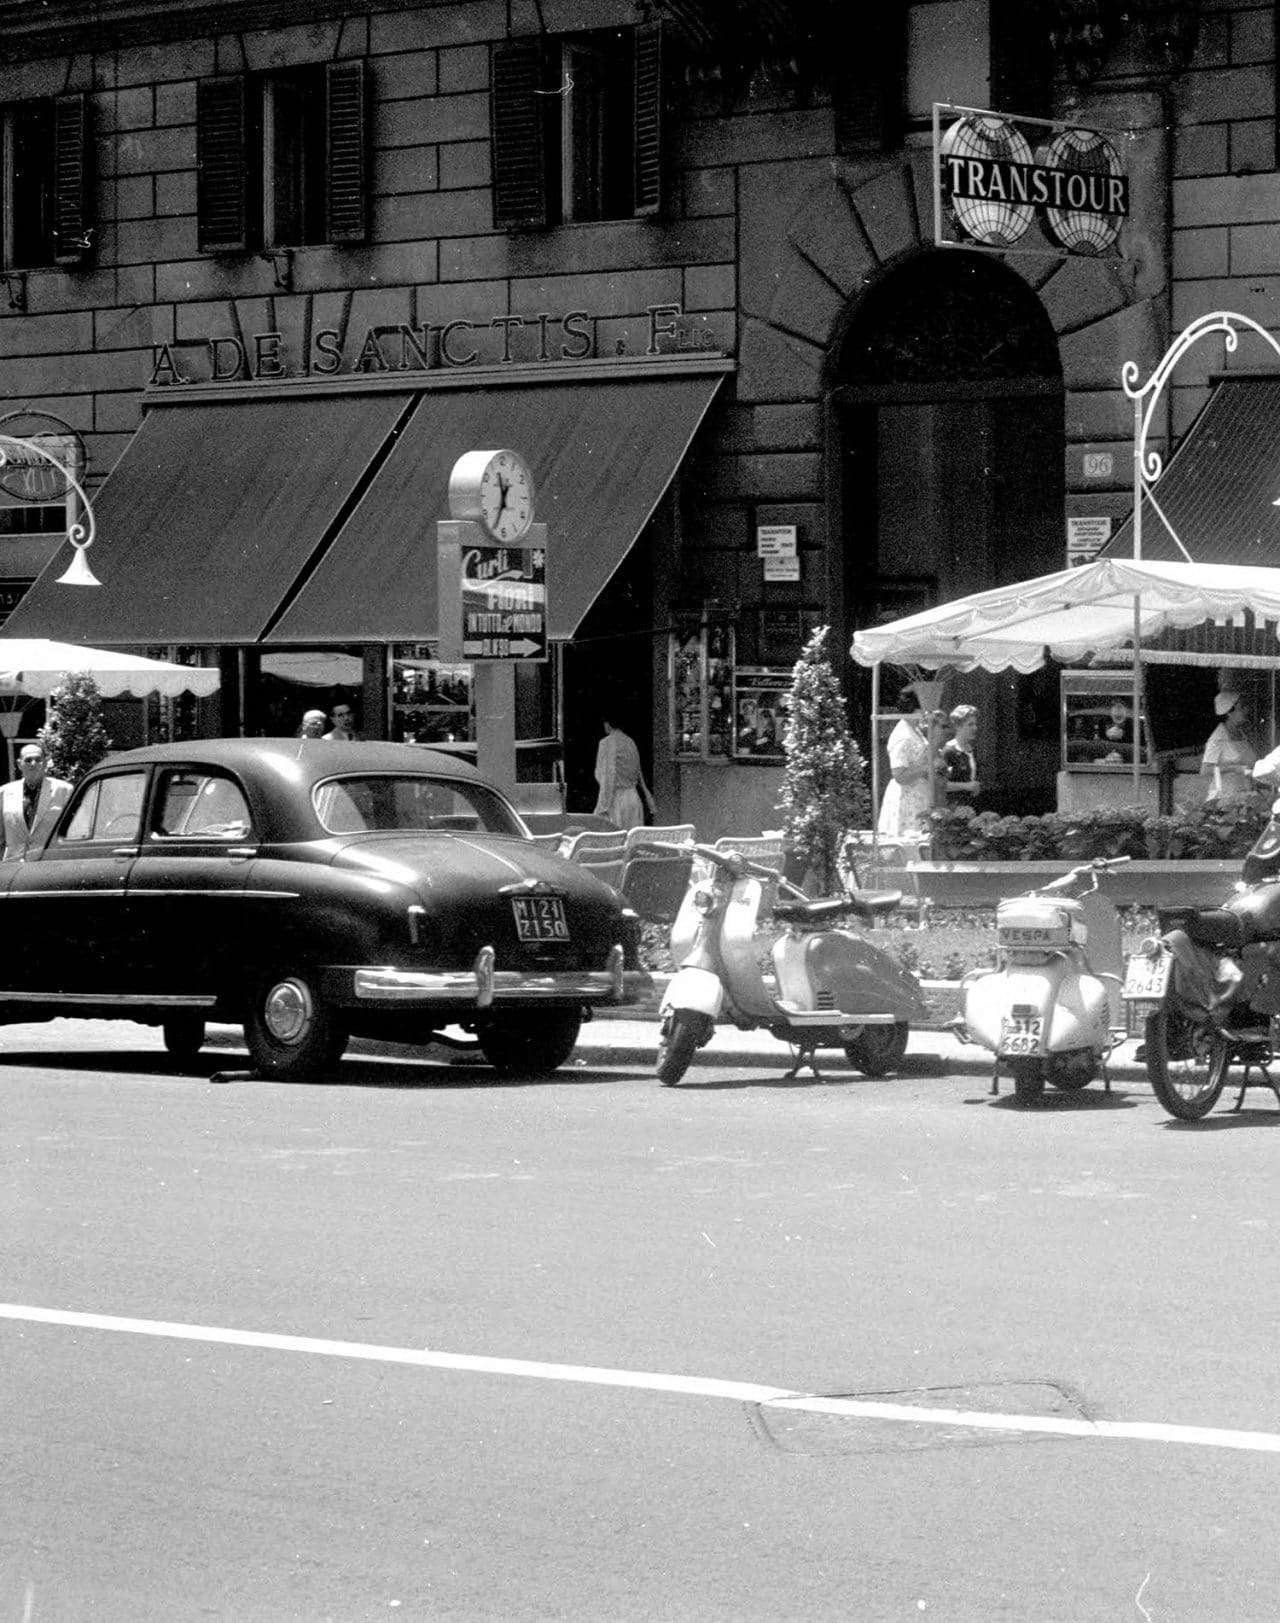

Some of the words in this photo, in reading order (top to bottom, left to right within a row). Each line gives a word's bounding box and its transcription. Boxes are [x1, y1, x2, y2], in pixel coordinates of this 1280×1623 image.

[948, 157, 1126, 213] TRANSTOUR
[209, 332, 286, 383] DE
[313, 311, 593, 375] SANCTIS
[1087, 456, 1109, 474] 96
